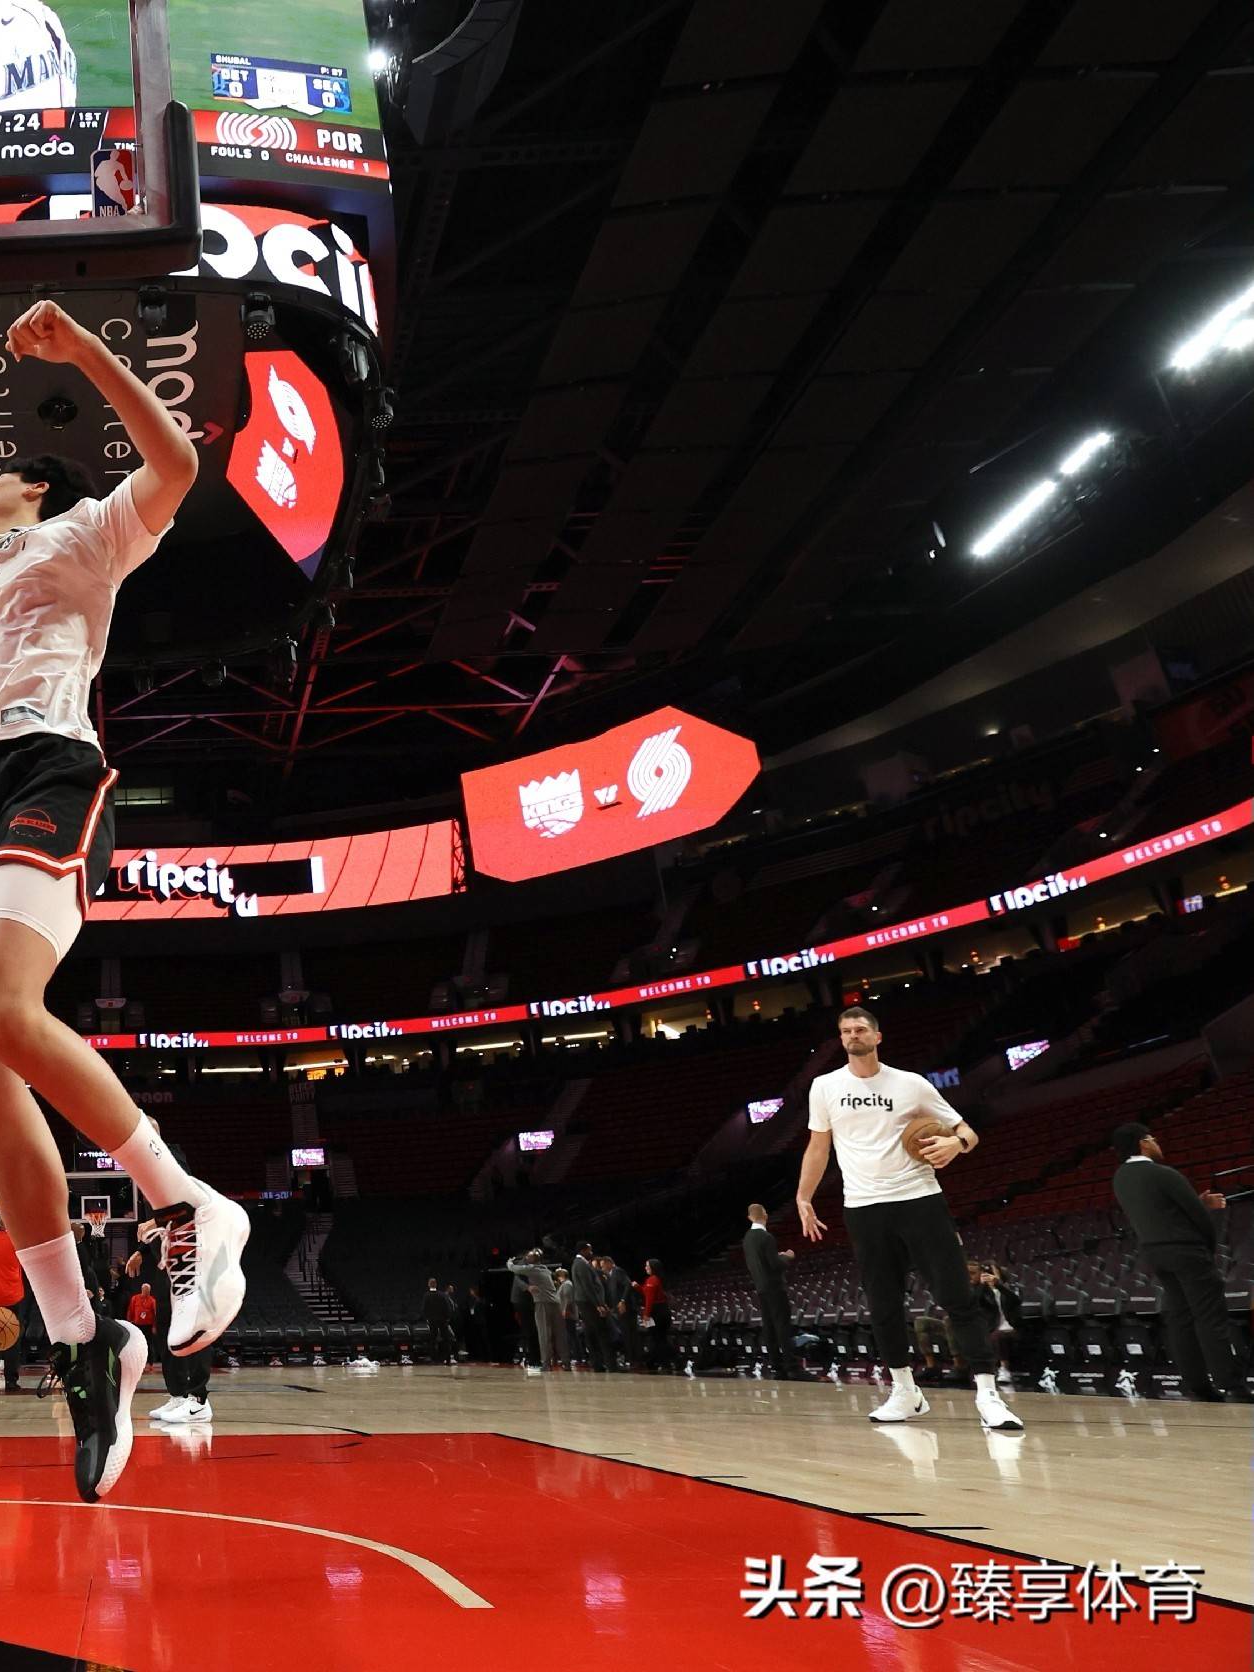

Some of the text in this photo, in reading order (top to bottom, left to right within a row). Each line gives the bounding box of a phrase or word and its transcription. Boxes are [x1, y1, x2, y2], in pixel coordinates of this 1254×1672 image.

[222, 69, 249, 82] DET
[229, 82, 244, 98] 0
[312, 78, 343, 93] SEA
[322, 92, 336, 108] 0
[78, 112, 102, 122] 1ST
[1, 137, 75, 159] moda
[316, 128, 364, 154] POR
[211, 145, 252, 160] FOULS
[285, 152, 355, 171] CHALLENGE
[99, 204, 120, 217] NBA
[1123, 830, 1195, 864] WELCOME
[866, 921, 926, 945] WELCOME
[639, 980, 691, 997] WELCOME
[431, 1014, 479, 1028] WELCOME
[236, 1033, 282, 1043] WELCOME
[840, 1093, 893, 1112] ripcity
